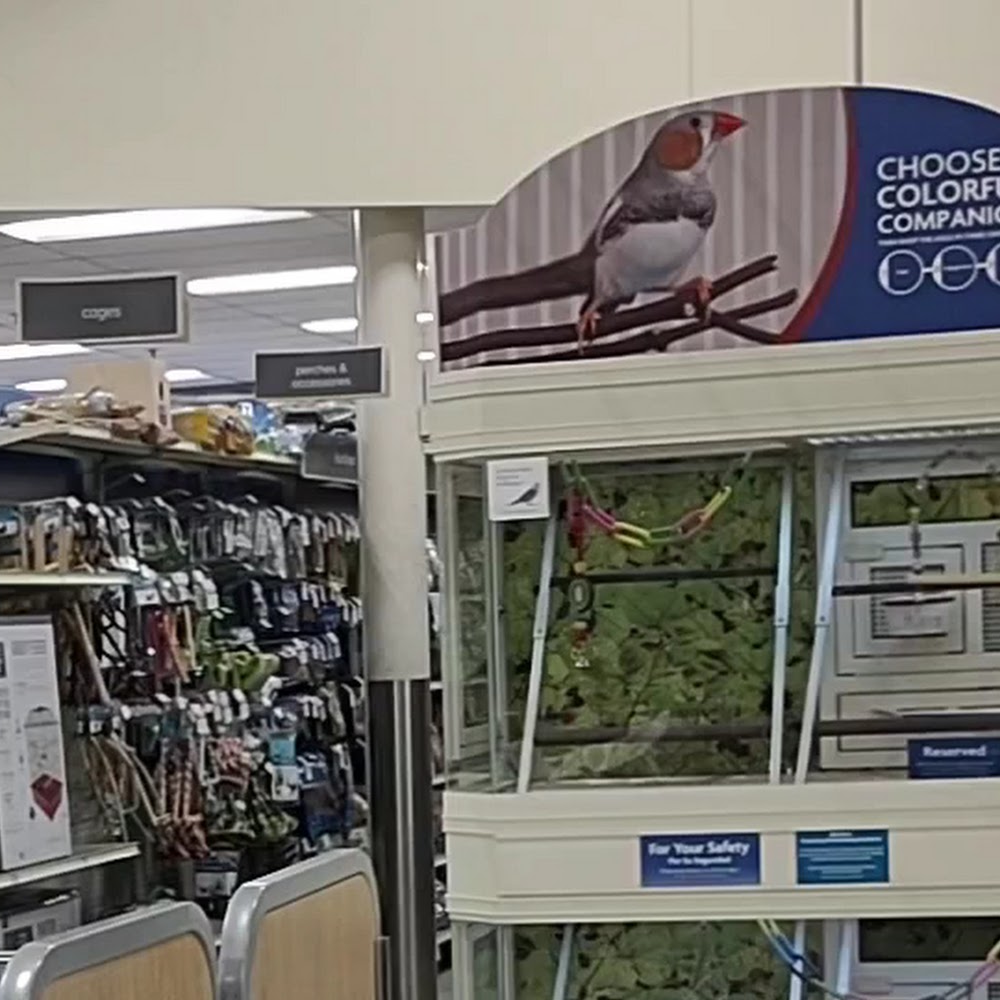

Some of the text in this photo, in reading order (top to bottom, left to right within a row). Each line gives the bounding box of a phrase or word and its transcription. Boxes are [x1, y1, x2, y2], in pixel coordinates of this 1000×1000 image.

[877, 148, 1000, 181] CHOOSE
[81, 307, 122, 321] cages
[923, 744, 987, 757] Reserved
[648, 840, 749, 856] For Your Safety
